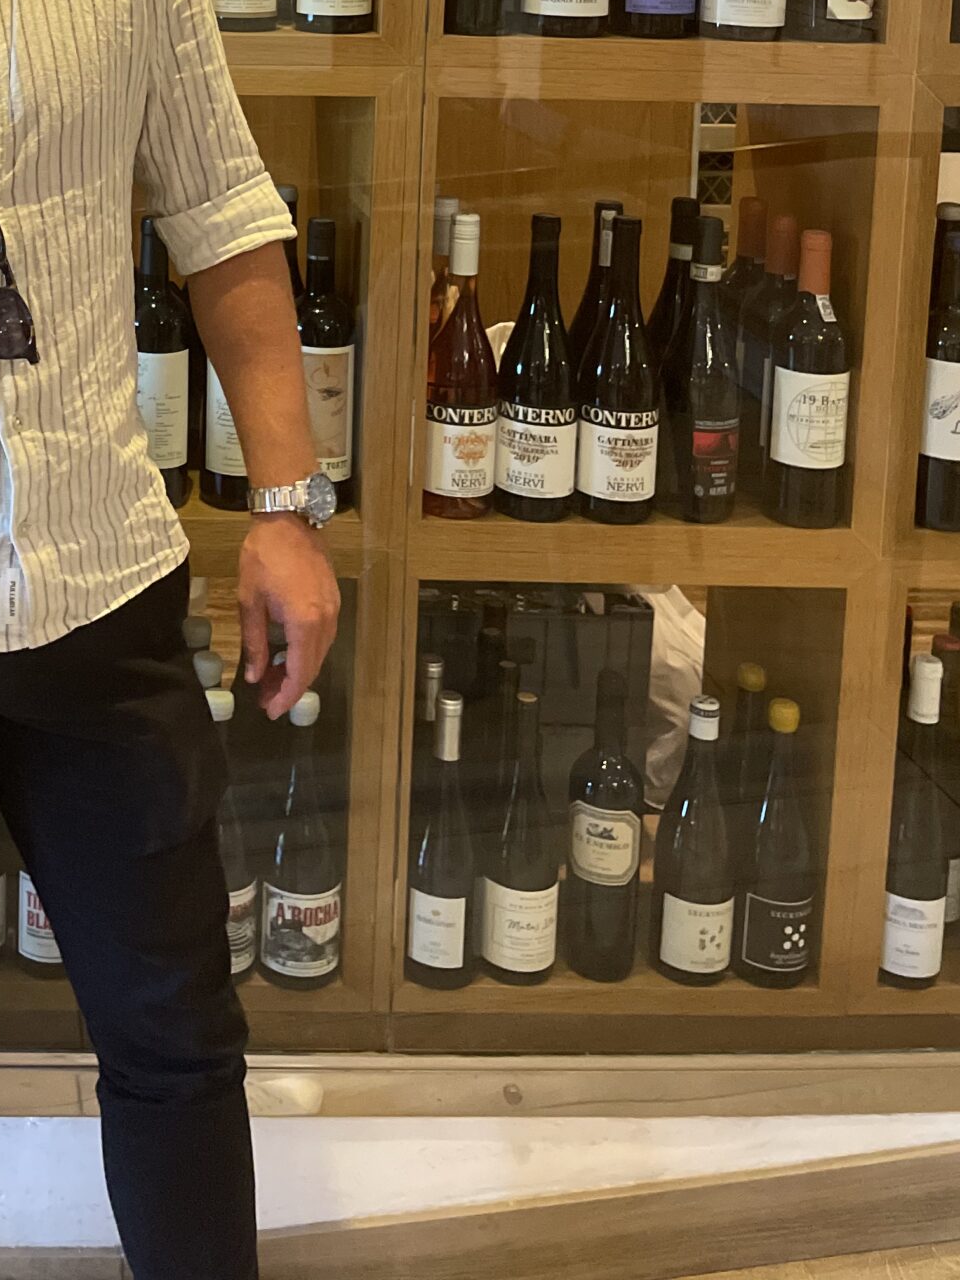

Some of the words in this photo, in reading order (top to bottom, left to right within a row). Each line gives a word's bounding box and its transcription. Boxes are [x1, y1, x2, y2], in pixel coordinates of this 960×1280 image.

[802, 393, 817, 406] 19
[500, 426, 558, 444] GATTINARA
[597, 435, 654, 447] GATTINARA
[615, 459, 642, 468] 2019
[451, 477, 487, 488] NERVI
[506, 473, 545, 489] NERVI
[606, 481, 645, 492] NERVI
